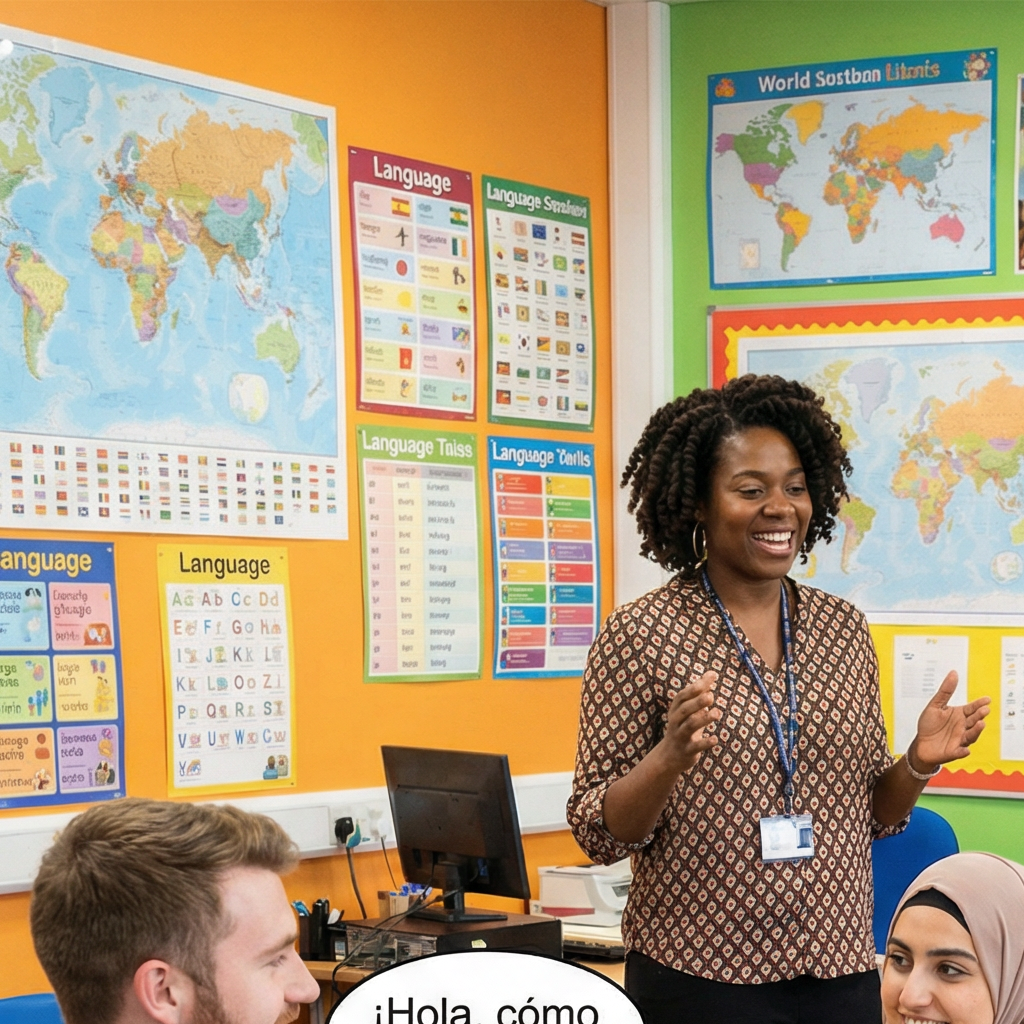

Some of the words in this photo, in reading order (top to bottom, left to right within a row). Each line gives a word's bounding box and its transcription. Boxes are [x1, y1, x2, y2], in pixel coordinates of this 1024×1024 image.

[758, 70, 811, 93] World
[373, 155, 452, 195] Language
[487, 182, 542, 212] Language
[362, 430, 434, 458] Language
[0, 550, 92, 578] anguage
[180, 551, 270, 580] Language
